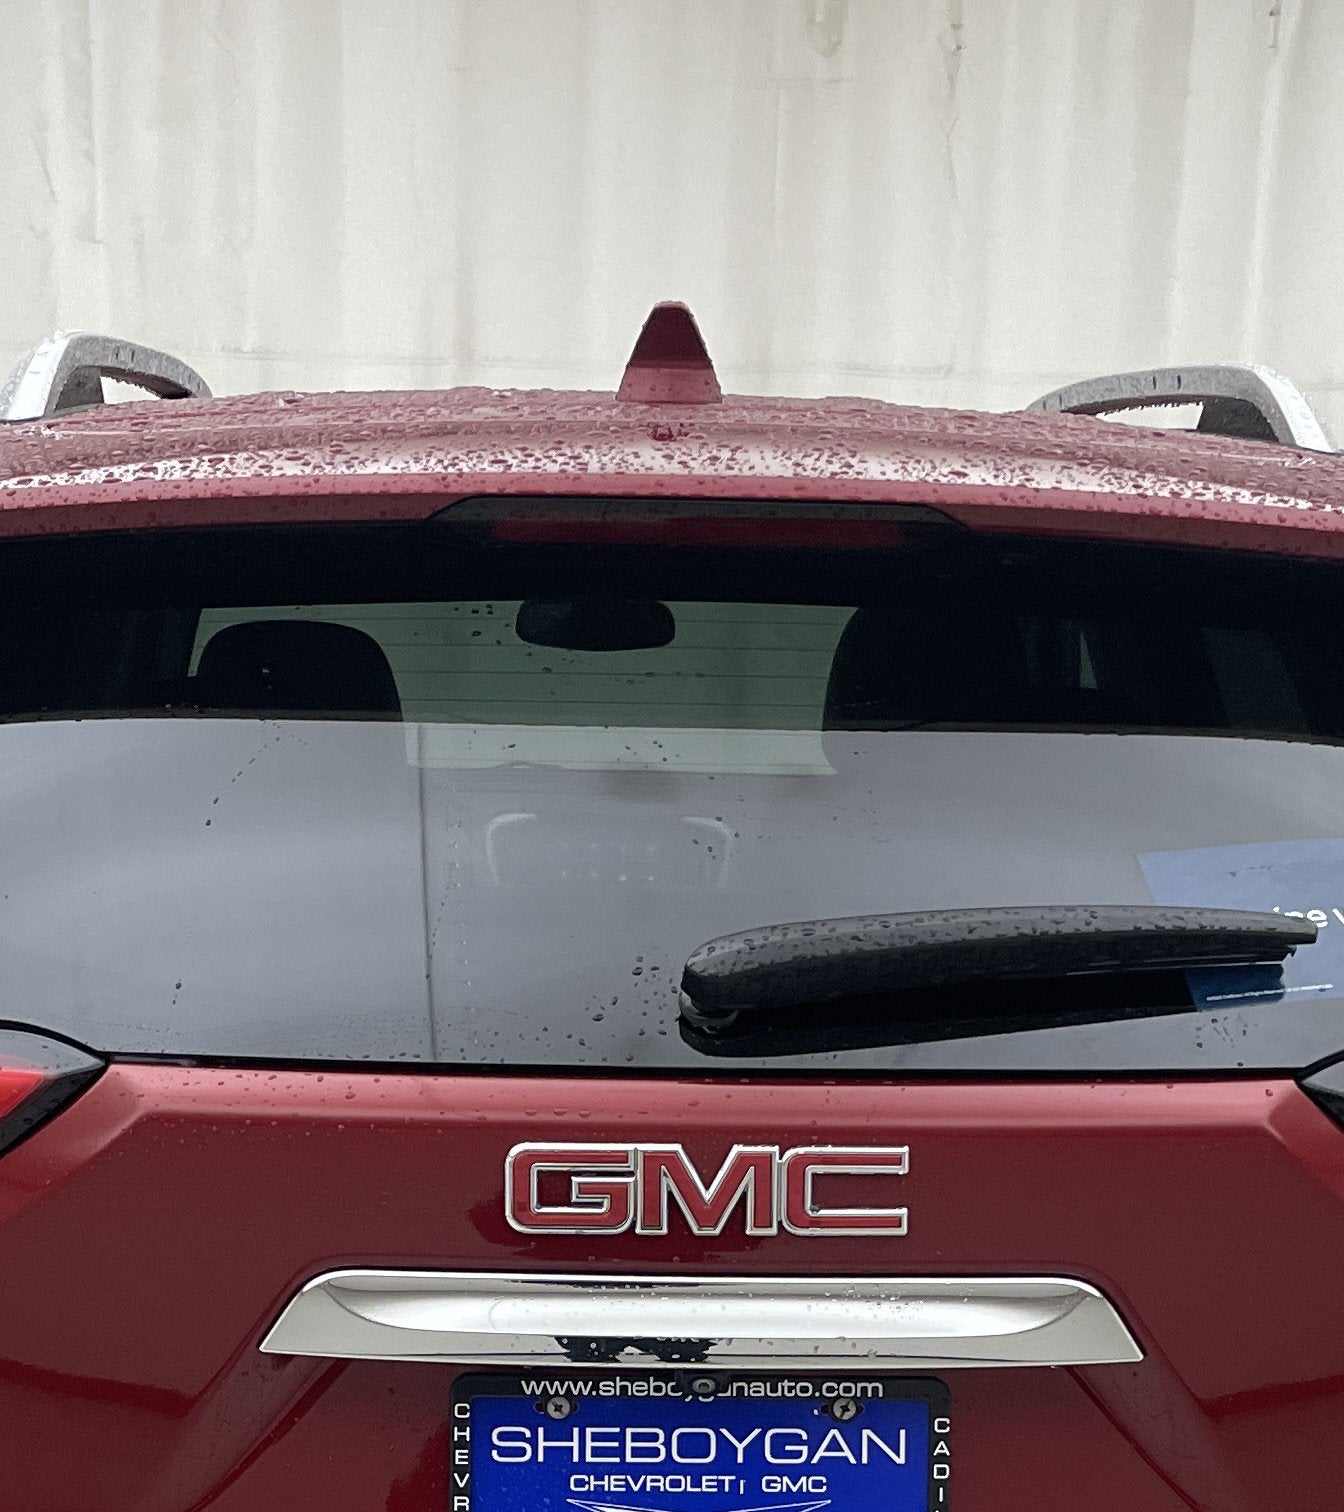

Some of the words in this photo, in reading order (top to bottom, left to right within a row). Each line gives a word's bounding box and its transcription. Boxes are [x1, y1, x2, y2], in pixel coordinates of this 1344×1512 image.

[504, 1141, 910, 1237] GMC
[520, 1375, 885, 1402] www.shebonauto.com
[490, 1426, 908, 1466] SHEBOYGAN
[569, 1474, 737, 1493] CHEVROLET
[761, 1475, 828, 1494] GMC
